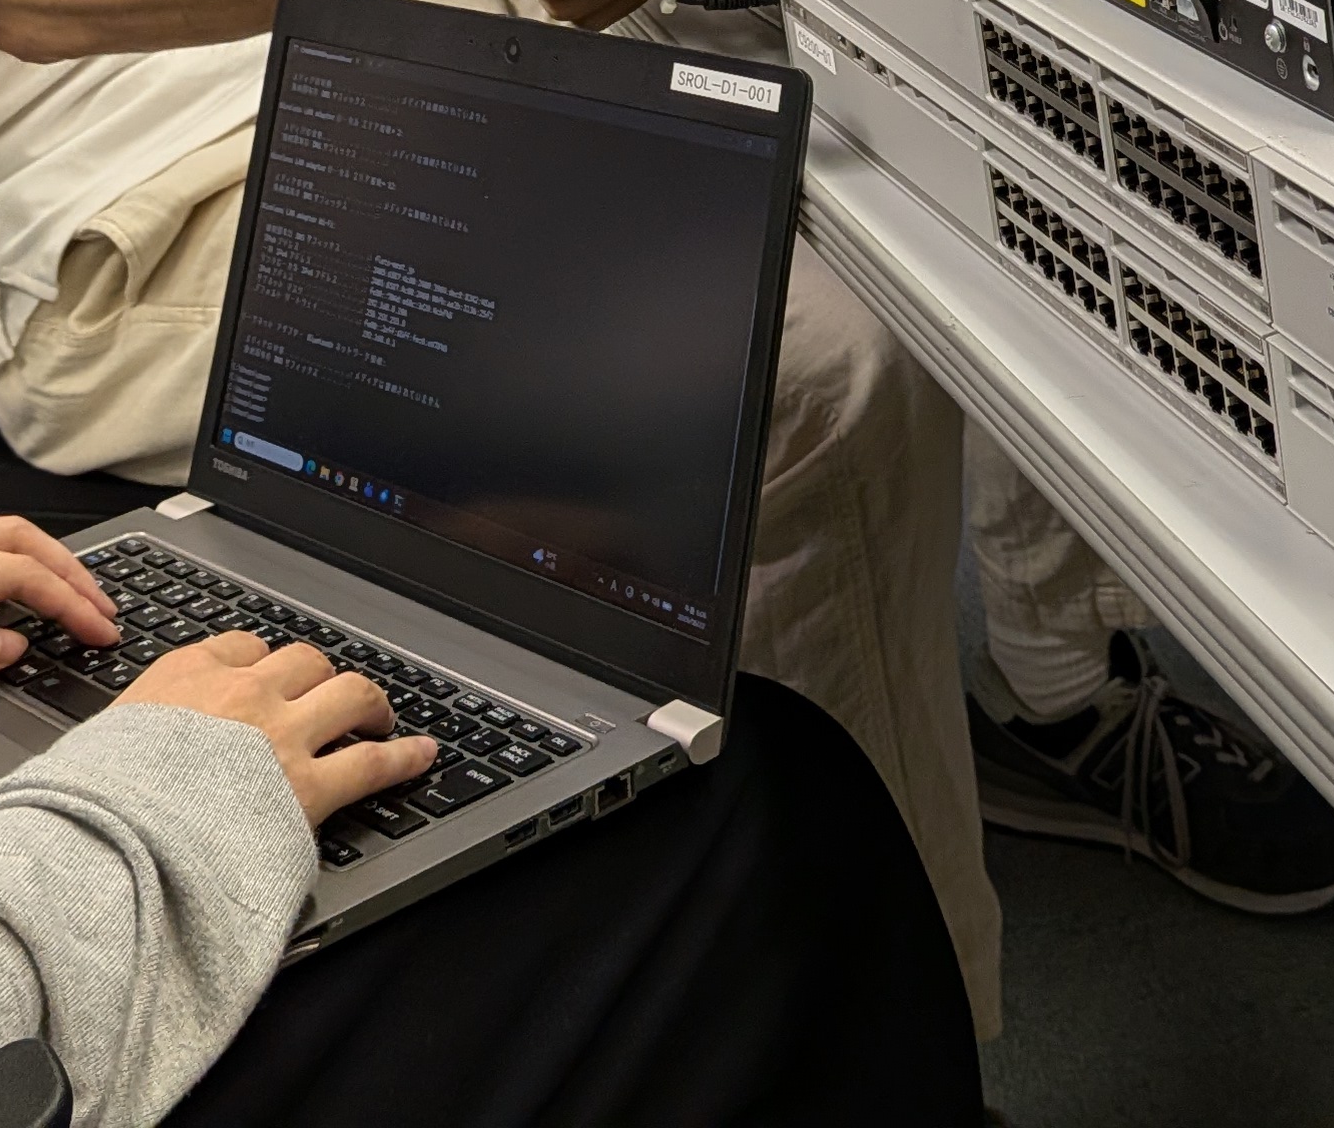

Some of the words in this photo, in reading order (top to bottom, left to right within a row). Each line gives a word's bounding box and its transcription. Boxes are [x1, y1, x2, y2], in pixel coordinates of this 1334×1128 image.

[677, 70, 772, 104] SROL-D1-001
[551, 736, 568, 748] DEL
[498, 750, 524, 765] SPACE
[508, 744, 532, 758] BACK
[466, 769, 494, 785] ENTER
[375, 806, 400, 821] SHIFT
